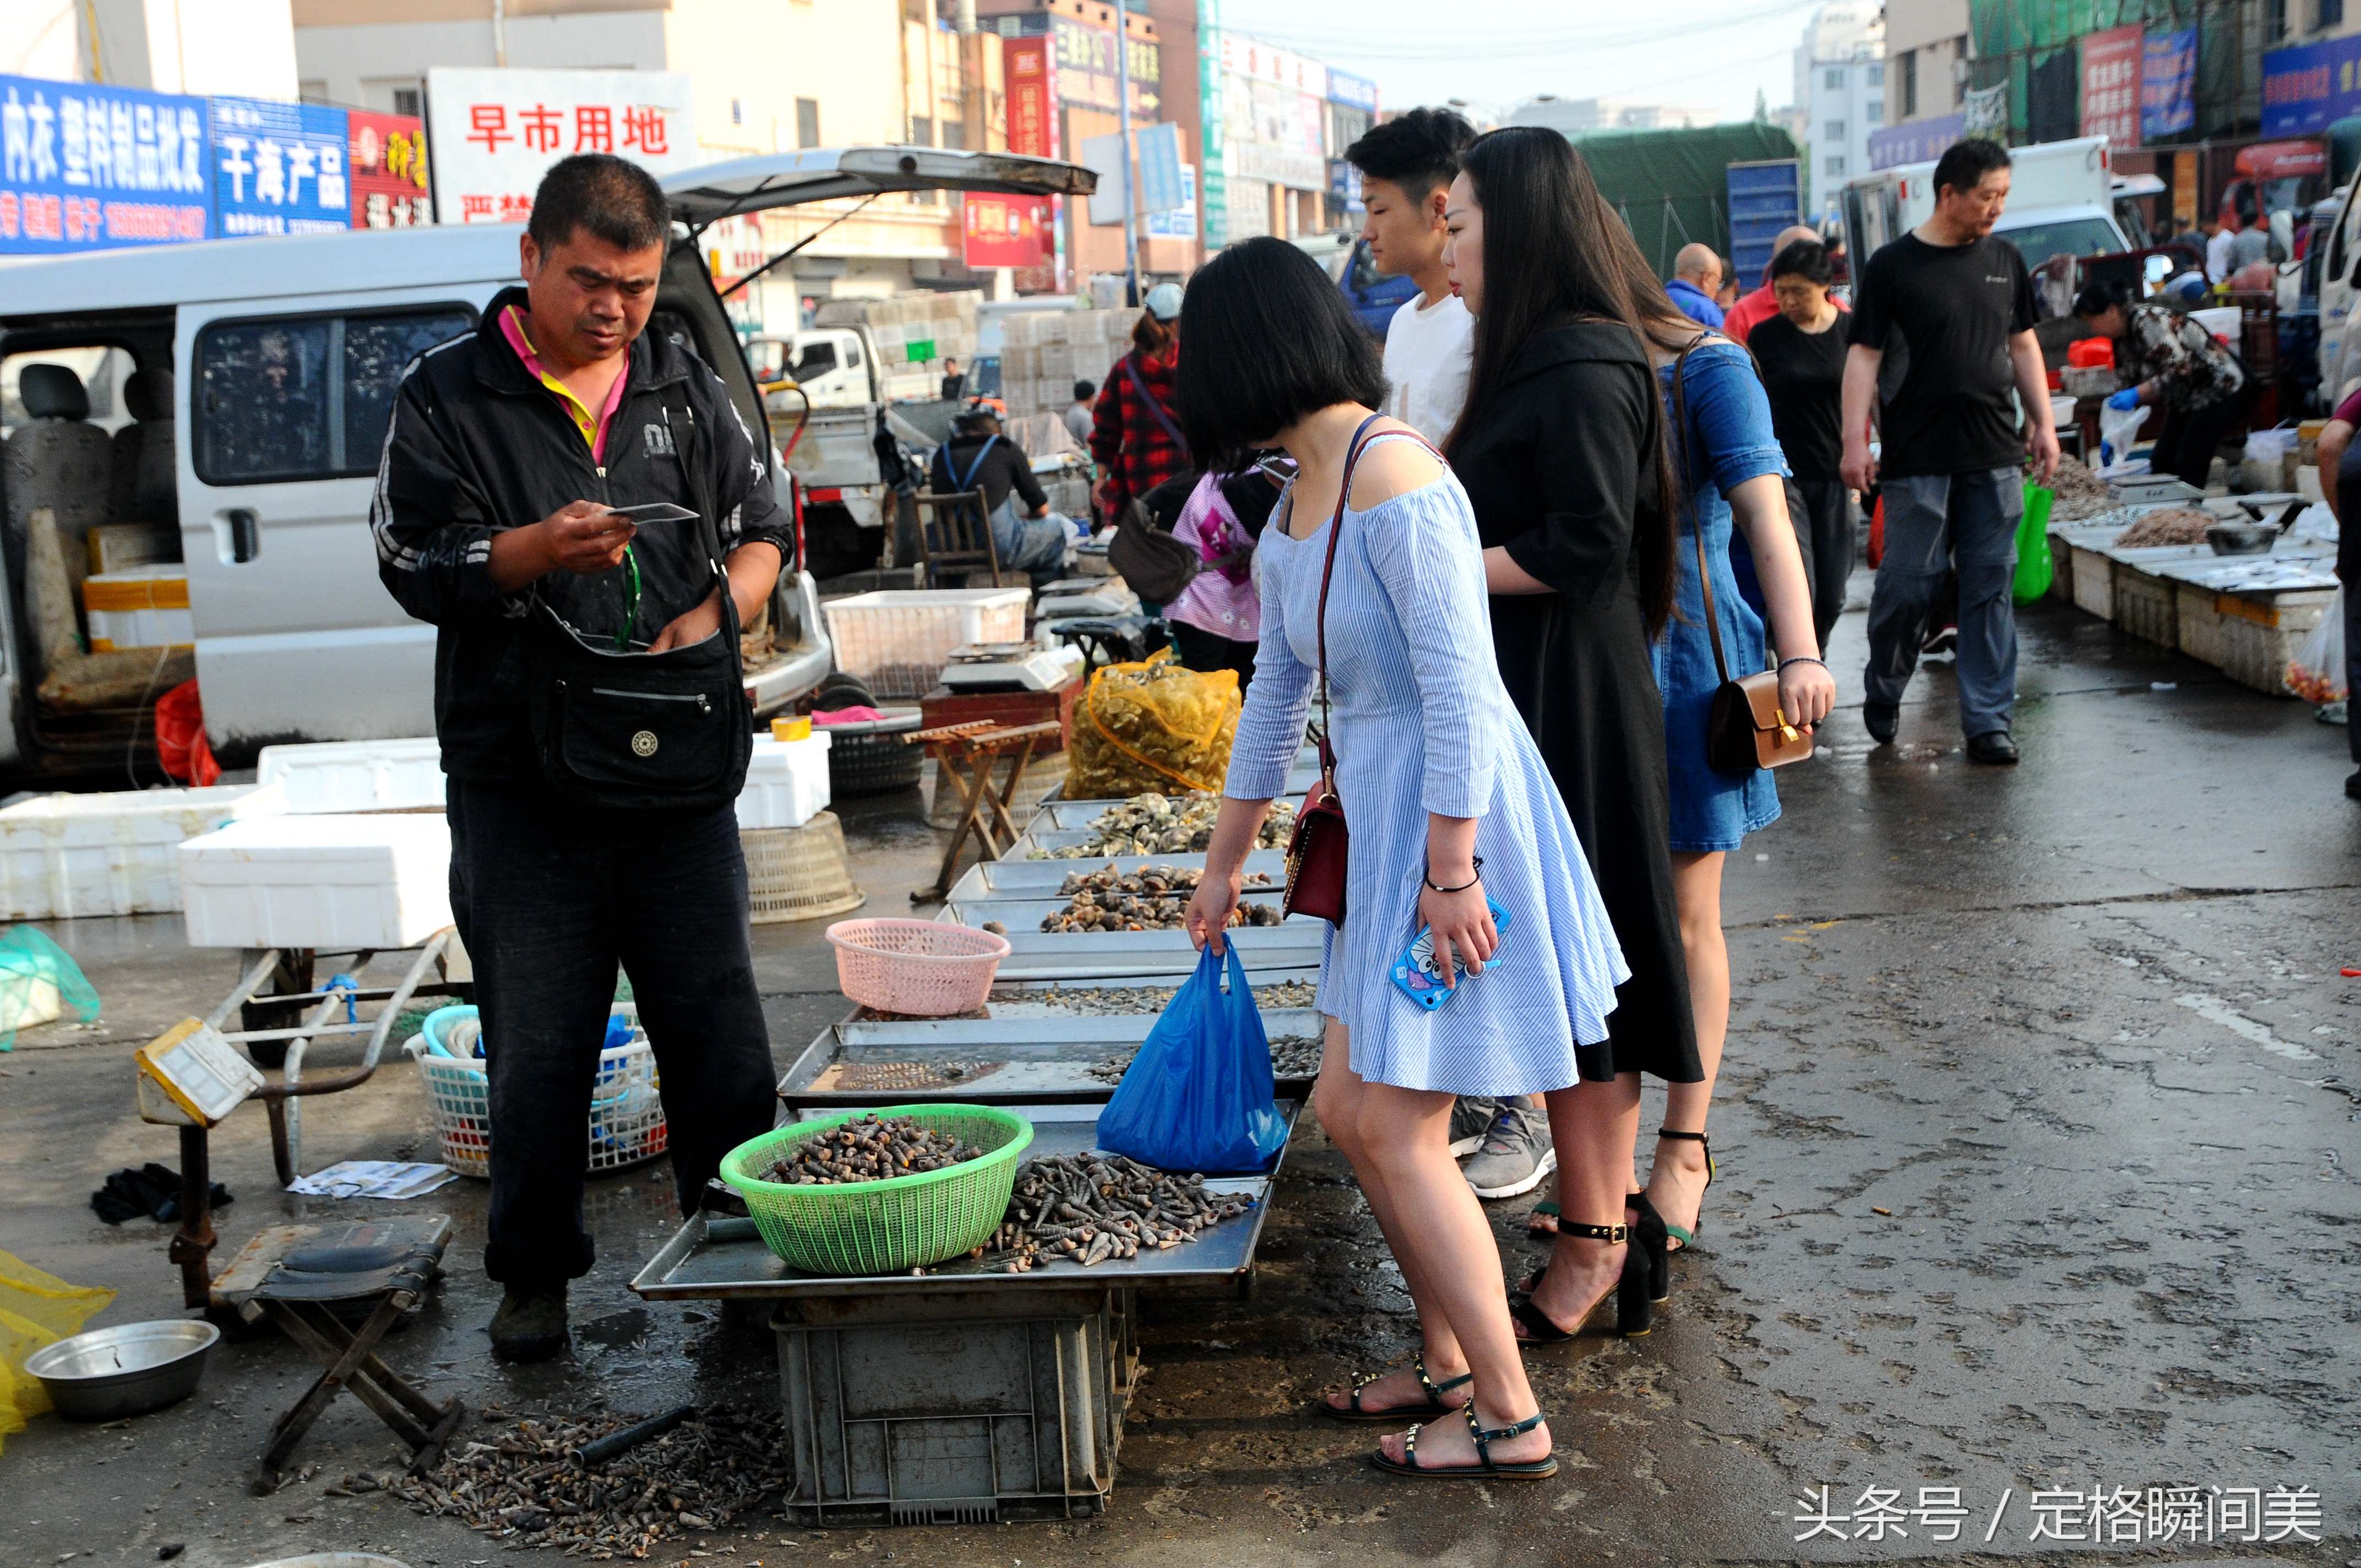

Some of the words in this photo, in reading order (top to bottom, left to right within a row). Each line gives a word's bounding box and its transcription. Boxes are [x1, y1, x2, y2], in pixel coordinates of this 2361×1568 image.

[466, 104, 670, 154] 早市用地
[221, 136, 347, 210] 干海产品
